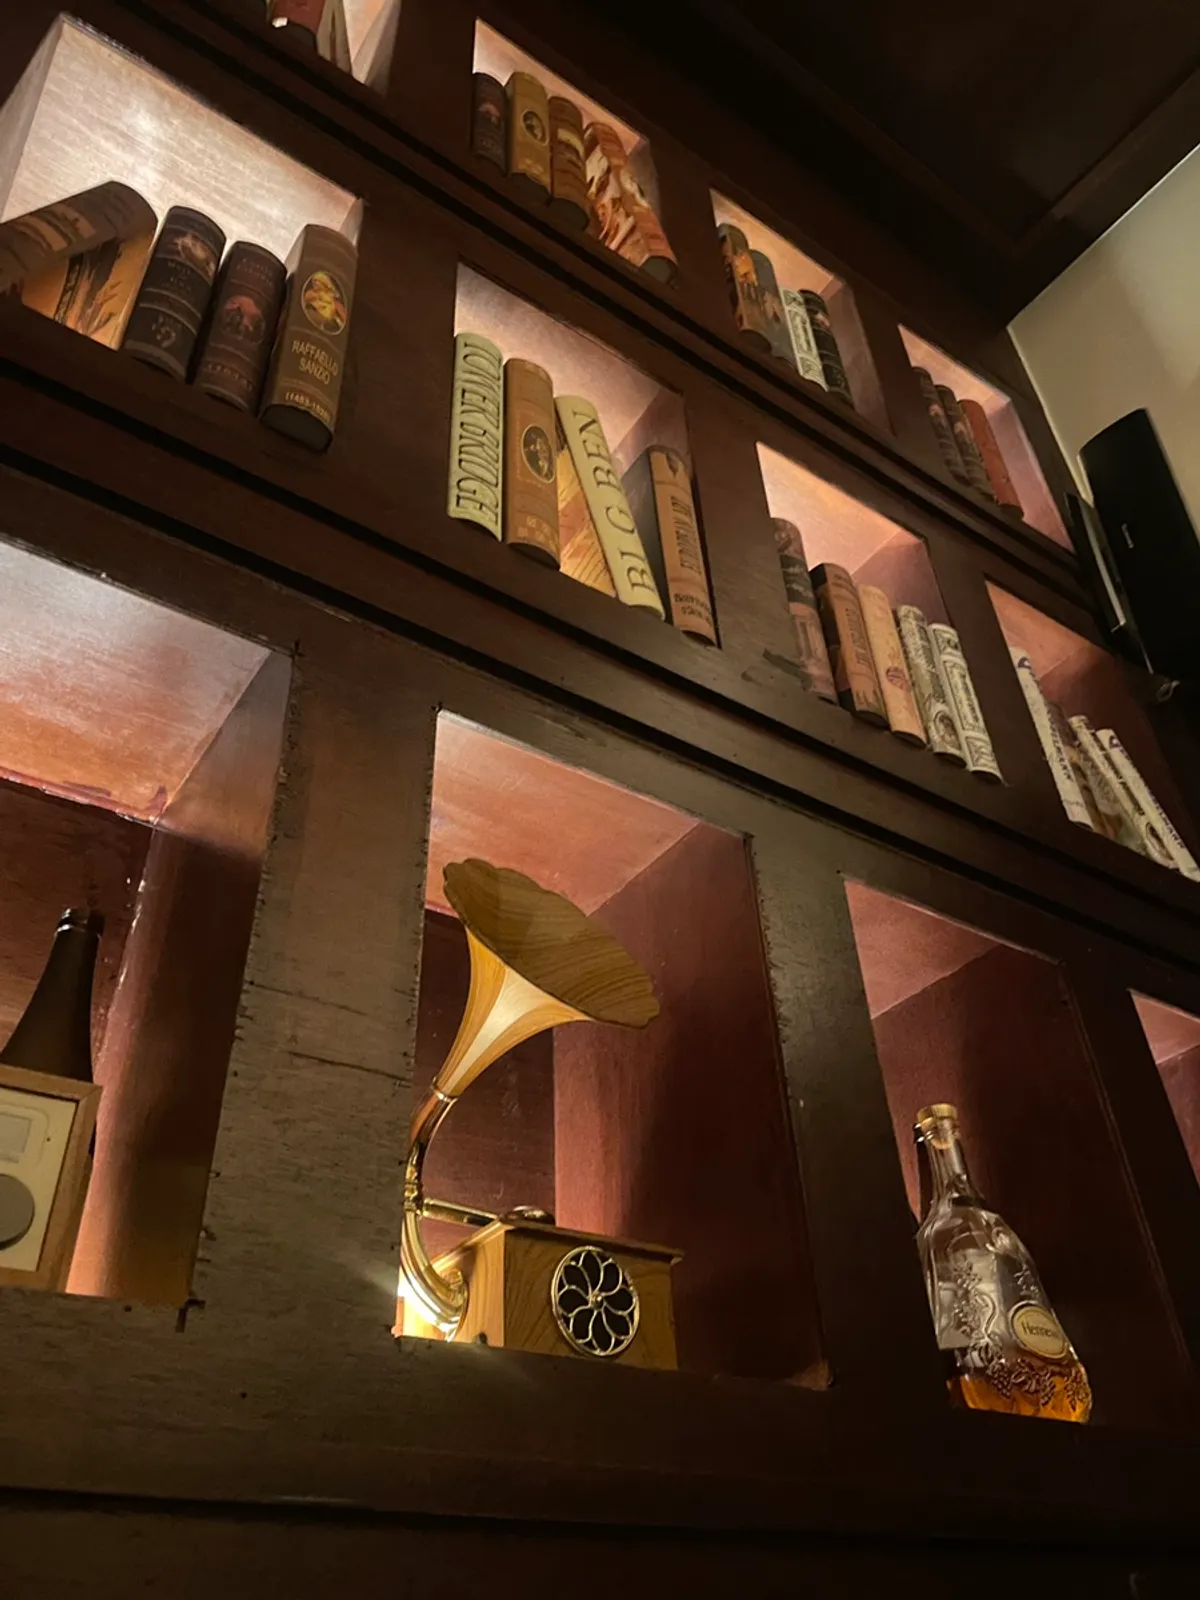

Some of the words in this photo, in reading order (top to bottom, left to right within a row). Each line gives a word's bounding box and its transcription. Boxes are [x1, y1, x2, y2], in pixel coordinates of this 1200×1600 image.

[291, 339, 339, 376] RAFFAELLO
[298, 356, 331, 385] SANZIO
[460, 341, 501, 429] TOWER
[455, 420, 499, 526] BRIDGE
[571, 407, 623, 492] BEN
[604, 505, 657, 593] BIG
[1021, 1321, 1057, 1339] Henne
